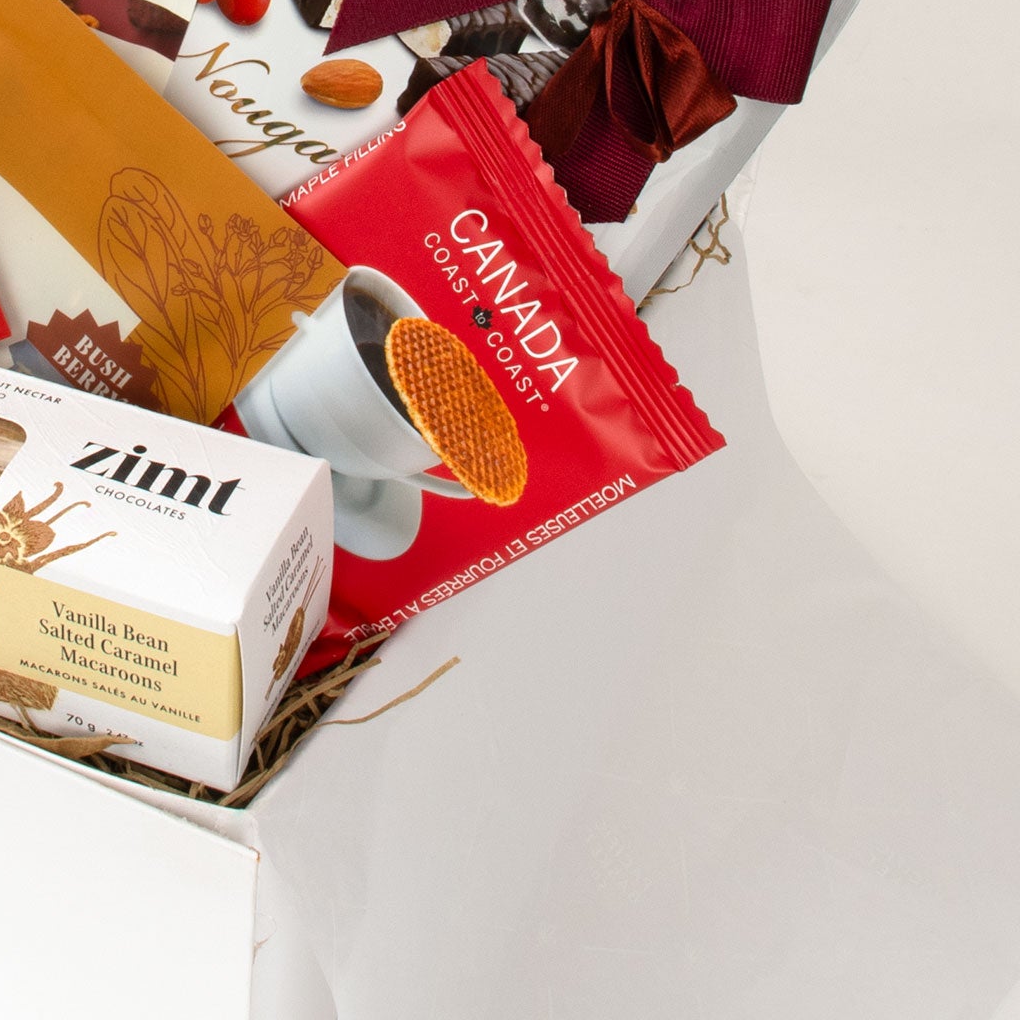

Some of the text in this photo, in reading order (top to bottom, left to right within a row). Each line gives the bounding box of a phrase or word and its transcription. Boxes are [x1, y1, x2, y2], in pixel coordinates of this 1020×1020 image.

[178, 42, 342, 164] Nouga
[278, 162, 340, 209] MAPLE
[424, 232, 479, 305] COAST
[475, 311, 486, 325] to
[449, 209, 579, 393] CANADA
[52, 344, 129, 403] BERR
[74, 333, 133, 389] BUSH
[14, 385, 62, 405] NECTAR
[69, 441, 247, 516] zimt
[94, 484, 186, 521] CHOCOLATES
[526, 473, 637, 546] MOELLEUSES
[264, 526, 309, 604] Vanilla Bean
[505, 538, 529, 560] ET
[262, 533, 314, 633] Salted Caramel
[271, 566, 309, 636] Macaroons
[39, 617, 178, 677] Salted Caramel
[51, 599, 169, 653] Vanilla Bean
[20, 658, 201, 723] MACARONS SALÉS AU VANILLE
[60, 645, 163, 692] Macaroons
[66, 712, 84, 726] 70
[87, 723, 96, 733] g
